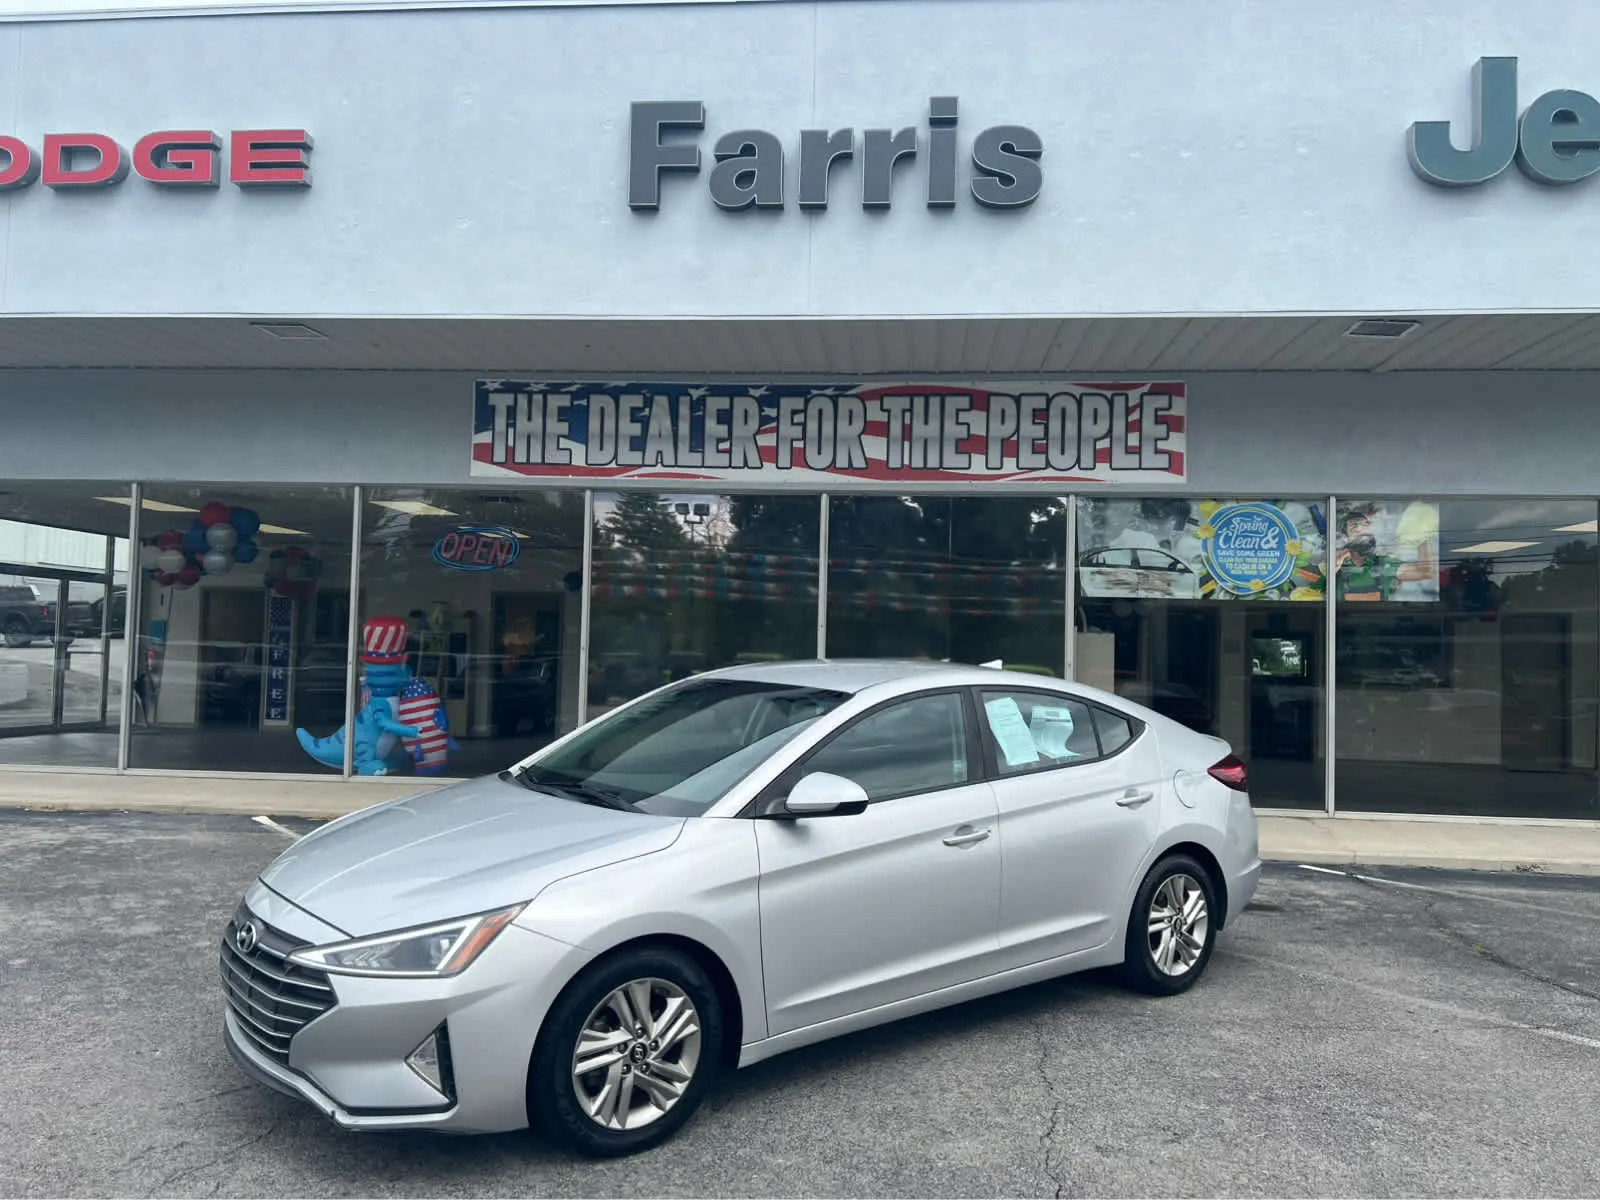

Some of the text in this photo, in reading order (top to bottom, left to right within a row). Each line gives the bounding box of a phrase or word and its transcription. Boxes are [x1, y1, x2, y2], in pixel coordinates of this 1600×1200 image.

[629, 97, 1044, 211] Farris
[488, 391, 1172, 472] THE DEALER FOR THE PEOPLE
[440, 532, 511, 568] OPEN
[1217, 526, 1281, 549] Clean &
[1230, 515, 1269, 536] Spring
[270, 649, 284, 719] FREE
